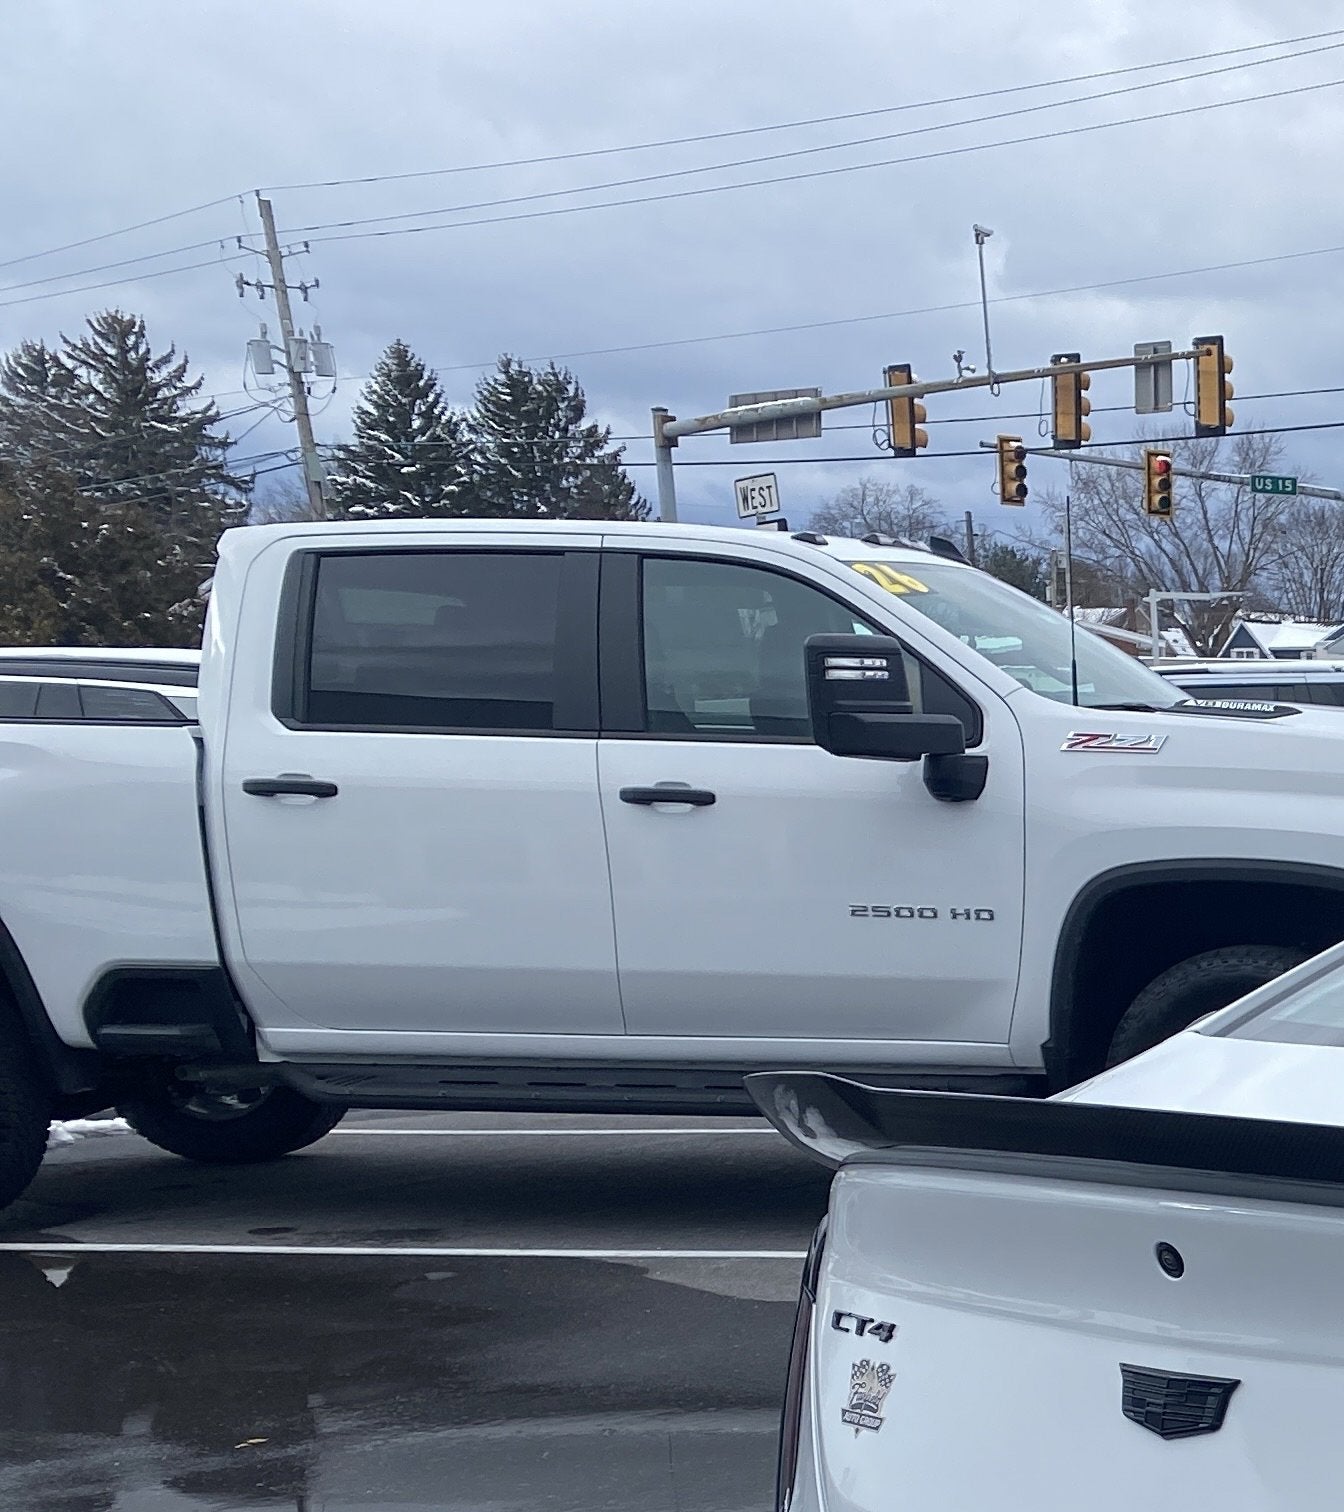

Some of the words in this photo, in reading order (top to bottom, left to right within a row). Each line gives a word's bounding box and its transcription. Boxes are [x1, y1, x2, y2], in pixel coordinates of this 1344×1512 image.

[1255, 477, 1273, 490] US
[1278, 479, 1293, 491] 15
[739, 485, 773, 511] WEST
[1221, 703, 1275, 712] DURAMAX
[1060, 731, 1169, 753] Z71
[848, 905, 938, 919] 2500
[950, 907, 995, 921] HD
[831, 1309, 897, 1343] CT4
